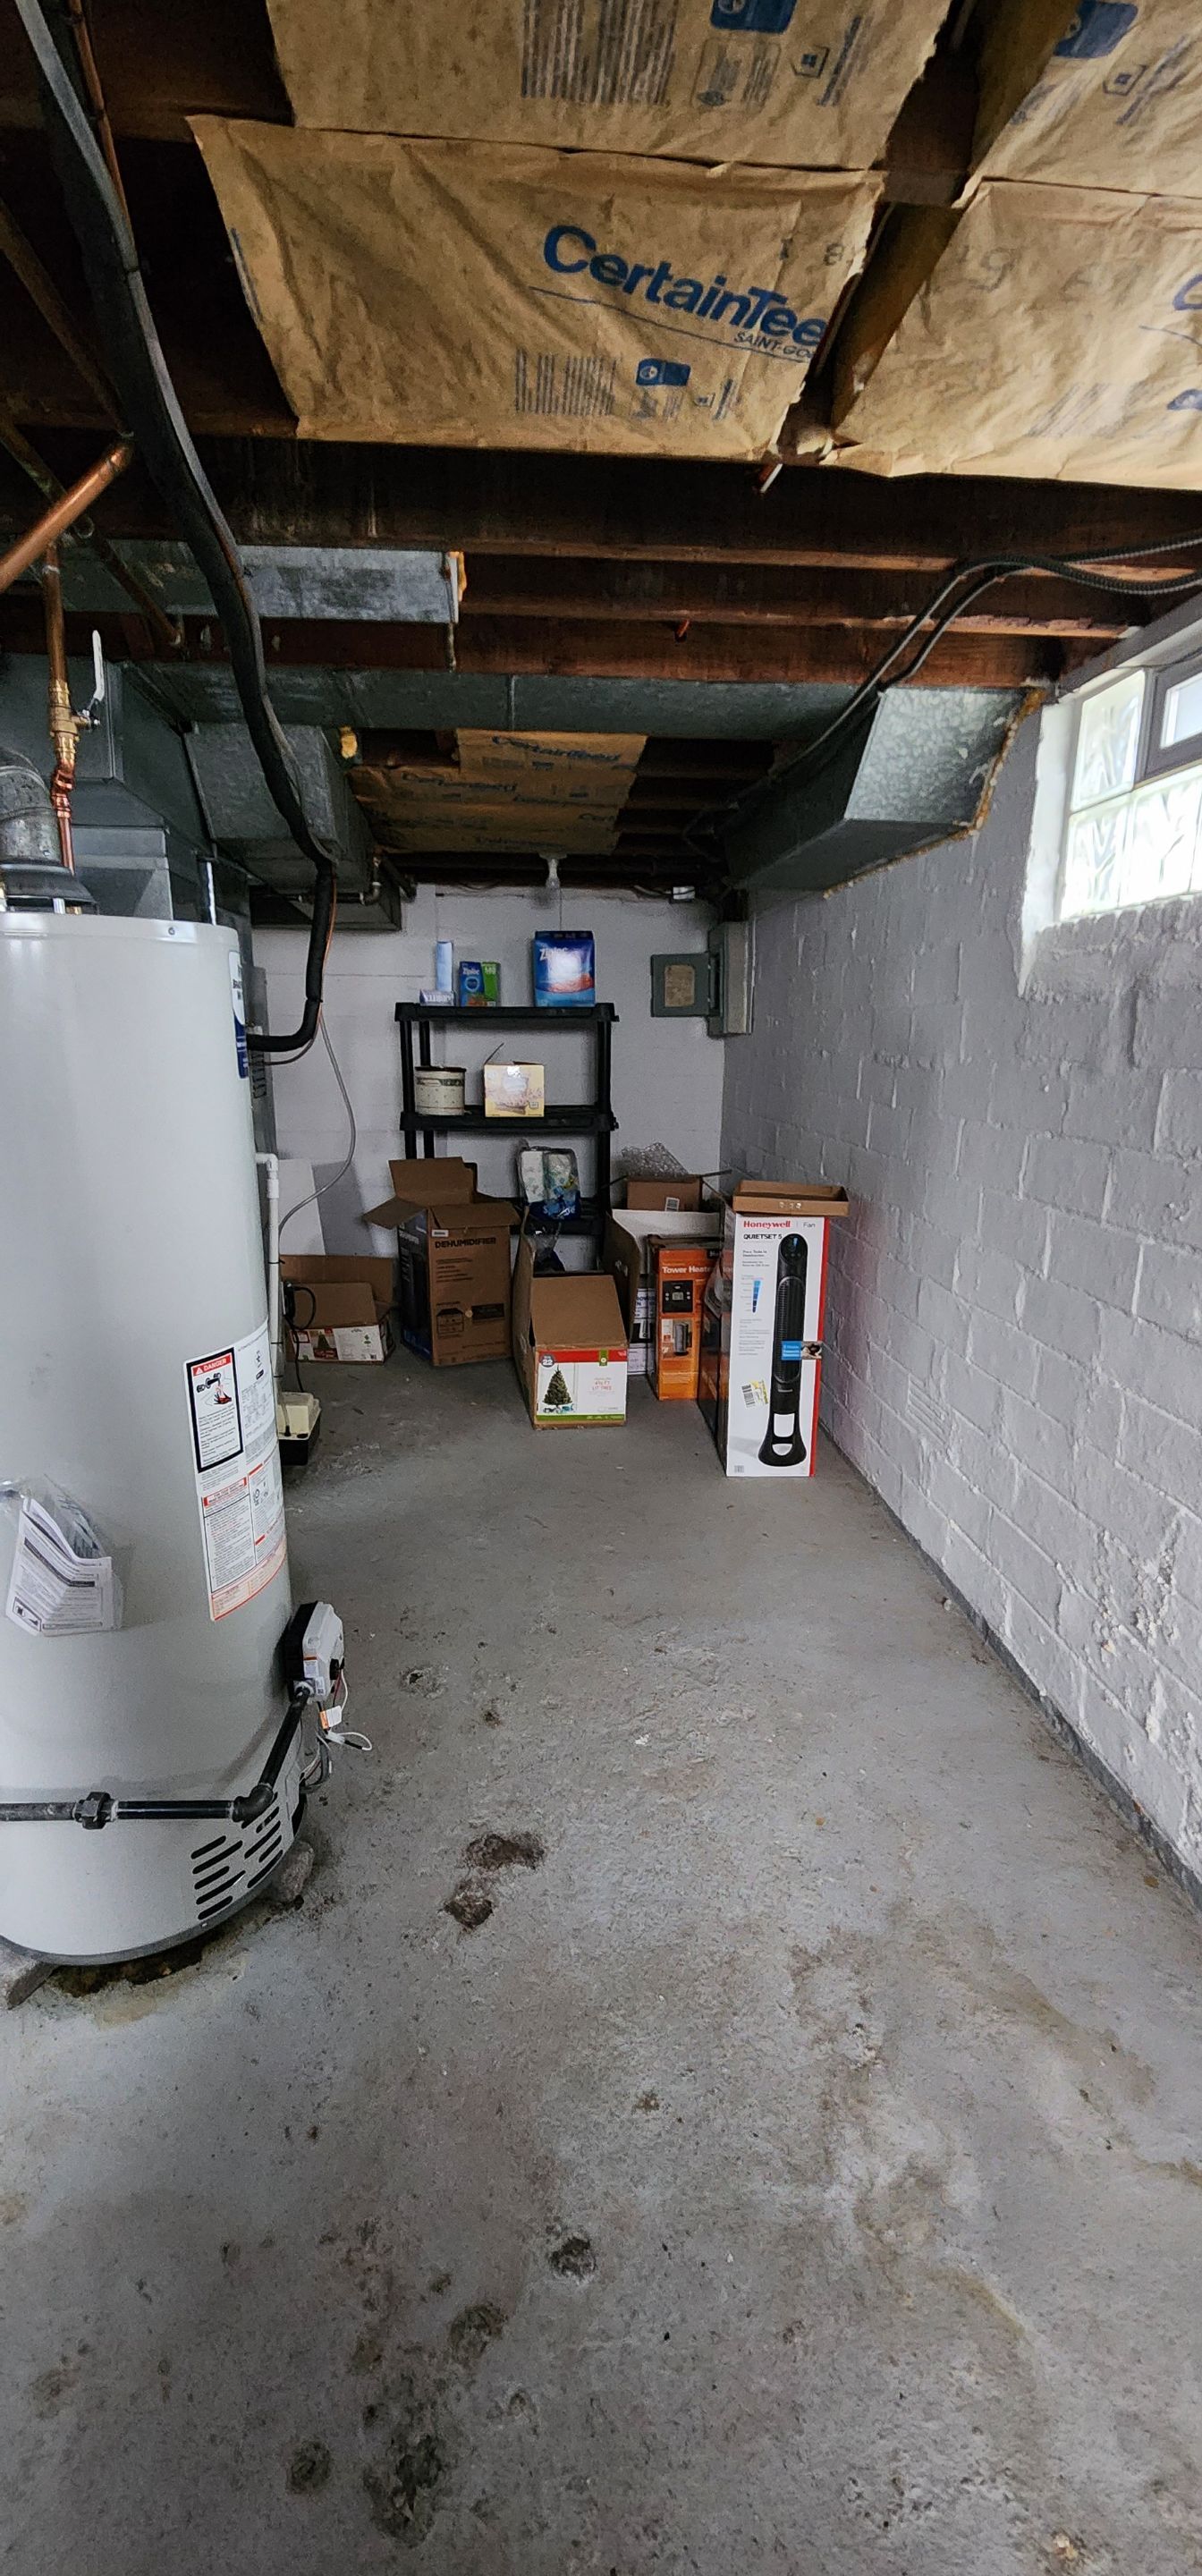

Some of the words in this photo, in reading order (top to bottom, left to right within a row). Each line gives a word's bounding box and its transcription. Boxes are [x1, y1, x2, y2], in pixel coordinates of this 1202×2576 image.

[543, 225, 828, 348] CertainTee
[743, 1220, 791, 1229] Honeywell
[435, 1237, 496, 1249] DEHUMIDIFIER
[662, 1266, 688, 1274] Tower
[203, 1358, 227, 1371] DANGER
